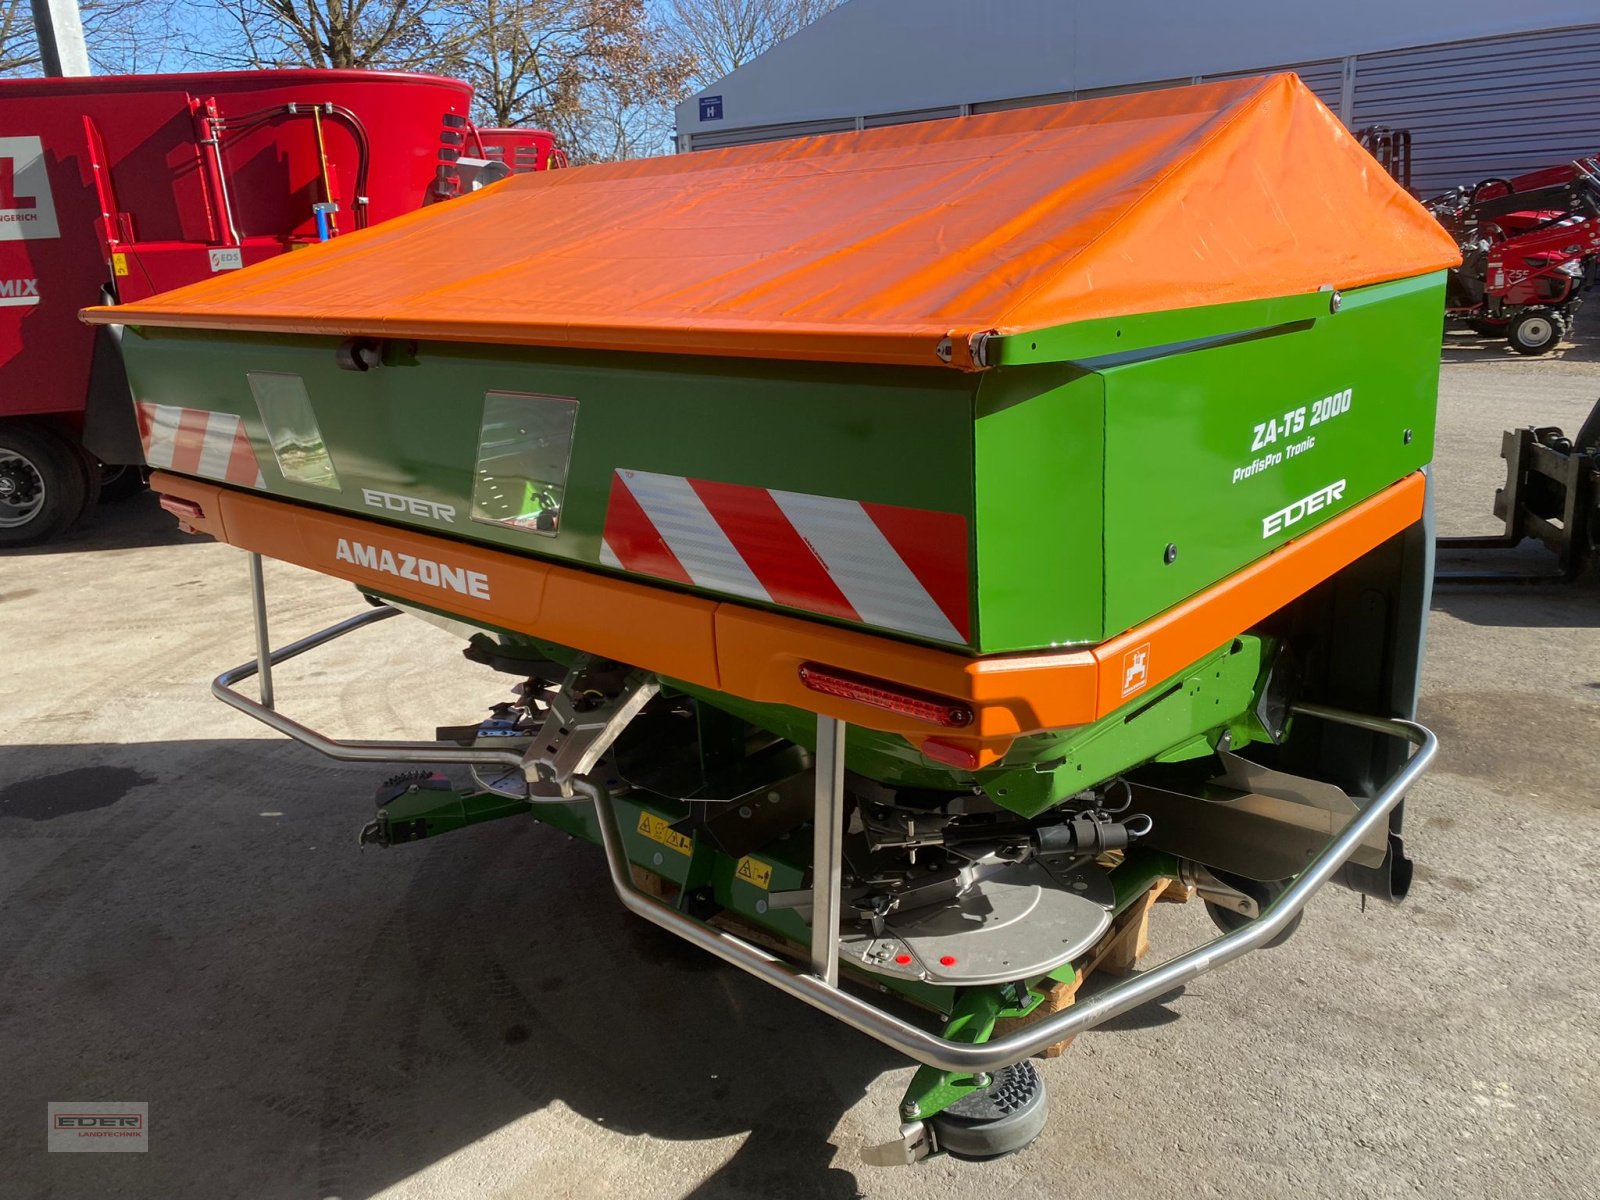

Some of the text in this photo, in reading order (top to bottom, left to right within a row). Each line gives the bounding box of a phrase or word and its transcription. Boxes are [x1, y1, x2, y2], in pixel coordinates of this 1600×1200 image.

[220, 253, 239, 262] EDS
[1251, 388, 1353, 452] ZA-TS 2000
[1232, 436, 1316, 484] ProfisPro Tronic
[361, 488, 456, 523] EDER
[1262, 478, 1346, 539] EDER
[336, 538, 491, 600] AMAZONE
